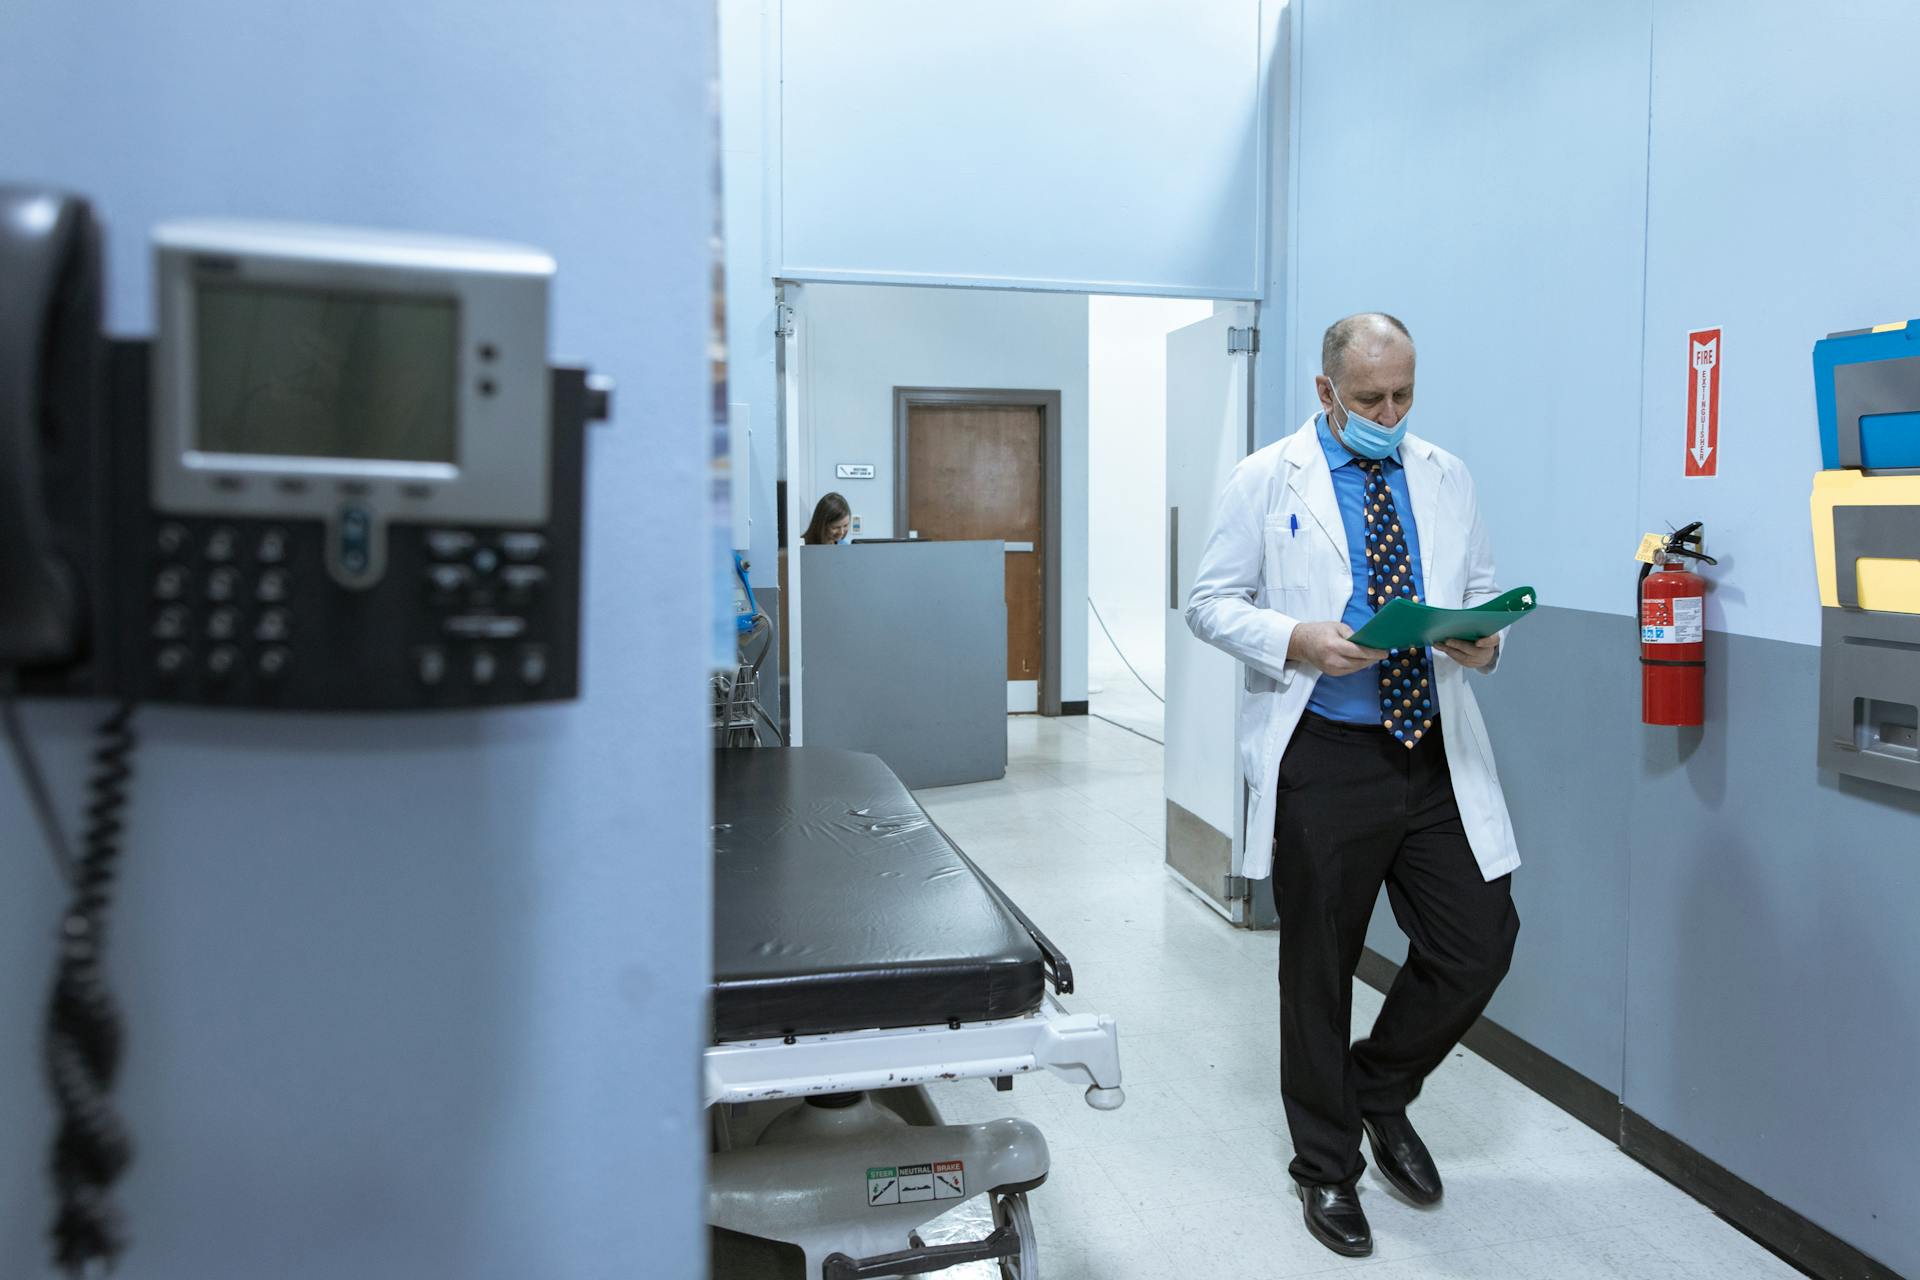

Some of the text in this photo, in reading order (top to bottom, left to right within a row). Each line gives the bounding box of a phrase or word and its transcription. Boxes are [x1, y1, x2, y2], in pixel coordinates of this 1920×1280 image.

[1697, 349, 1712, 365] FIRE
[1699, 370, 1707, 461] EXTINGUISHER
[870, 1163, 961, 1178] STEER NEUTRAL BRAKE
